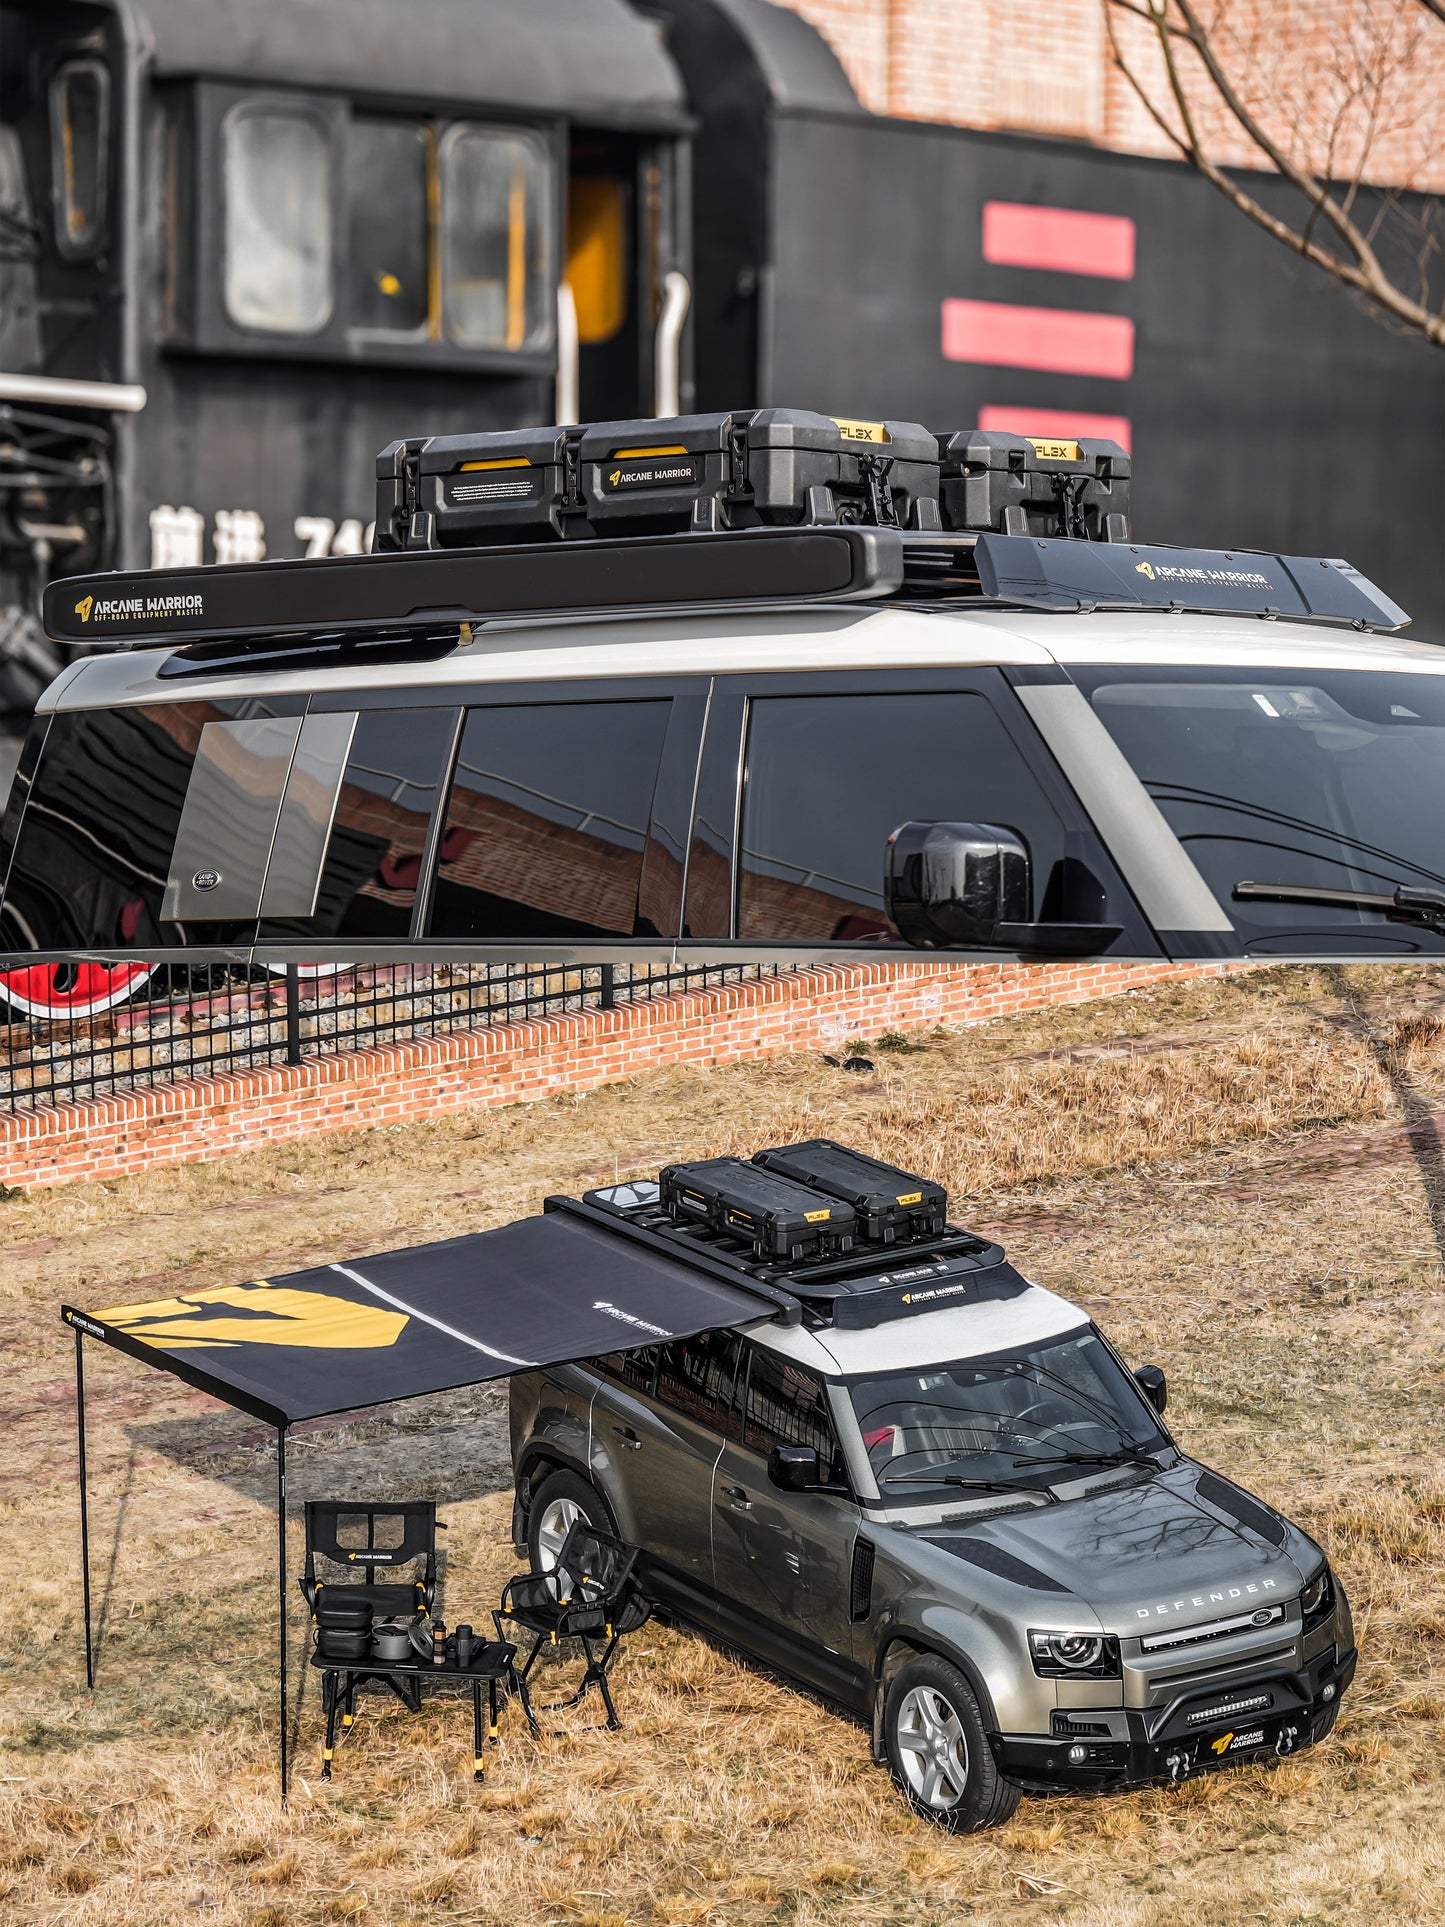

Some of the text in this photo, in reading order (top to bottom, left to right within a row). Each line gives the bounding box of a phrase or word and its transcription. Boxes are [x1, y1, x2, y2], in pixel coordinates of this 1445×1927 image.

[840, 427, 872, 440] FLEX
[1036, 446, 1067, 458] FLEX
[620, 468, 692, 483] ARCANE WARRIOR
[1155, 566, 1268, 584] ARCANE WARRIOR
[94, 595, 203, 614] ARCANE WARRIOR
[94, 608, 204, 622] OFF-ROAD EQUIPMENT MASTER
[911, 1290, 936, 1300] ARCANE
[935, 1284, 965, 1296] WARRIOR
[1136, 1579, 1276, 1618] DEFENDER
[1230, 1736, 1264, 1749] WARRIOR
[1233, 1730, 1264, 1743] ARCANE
